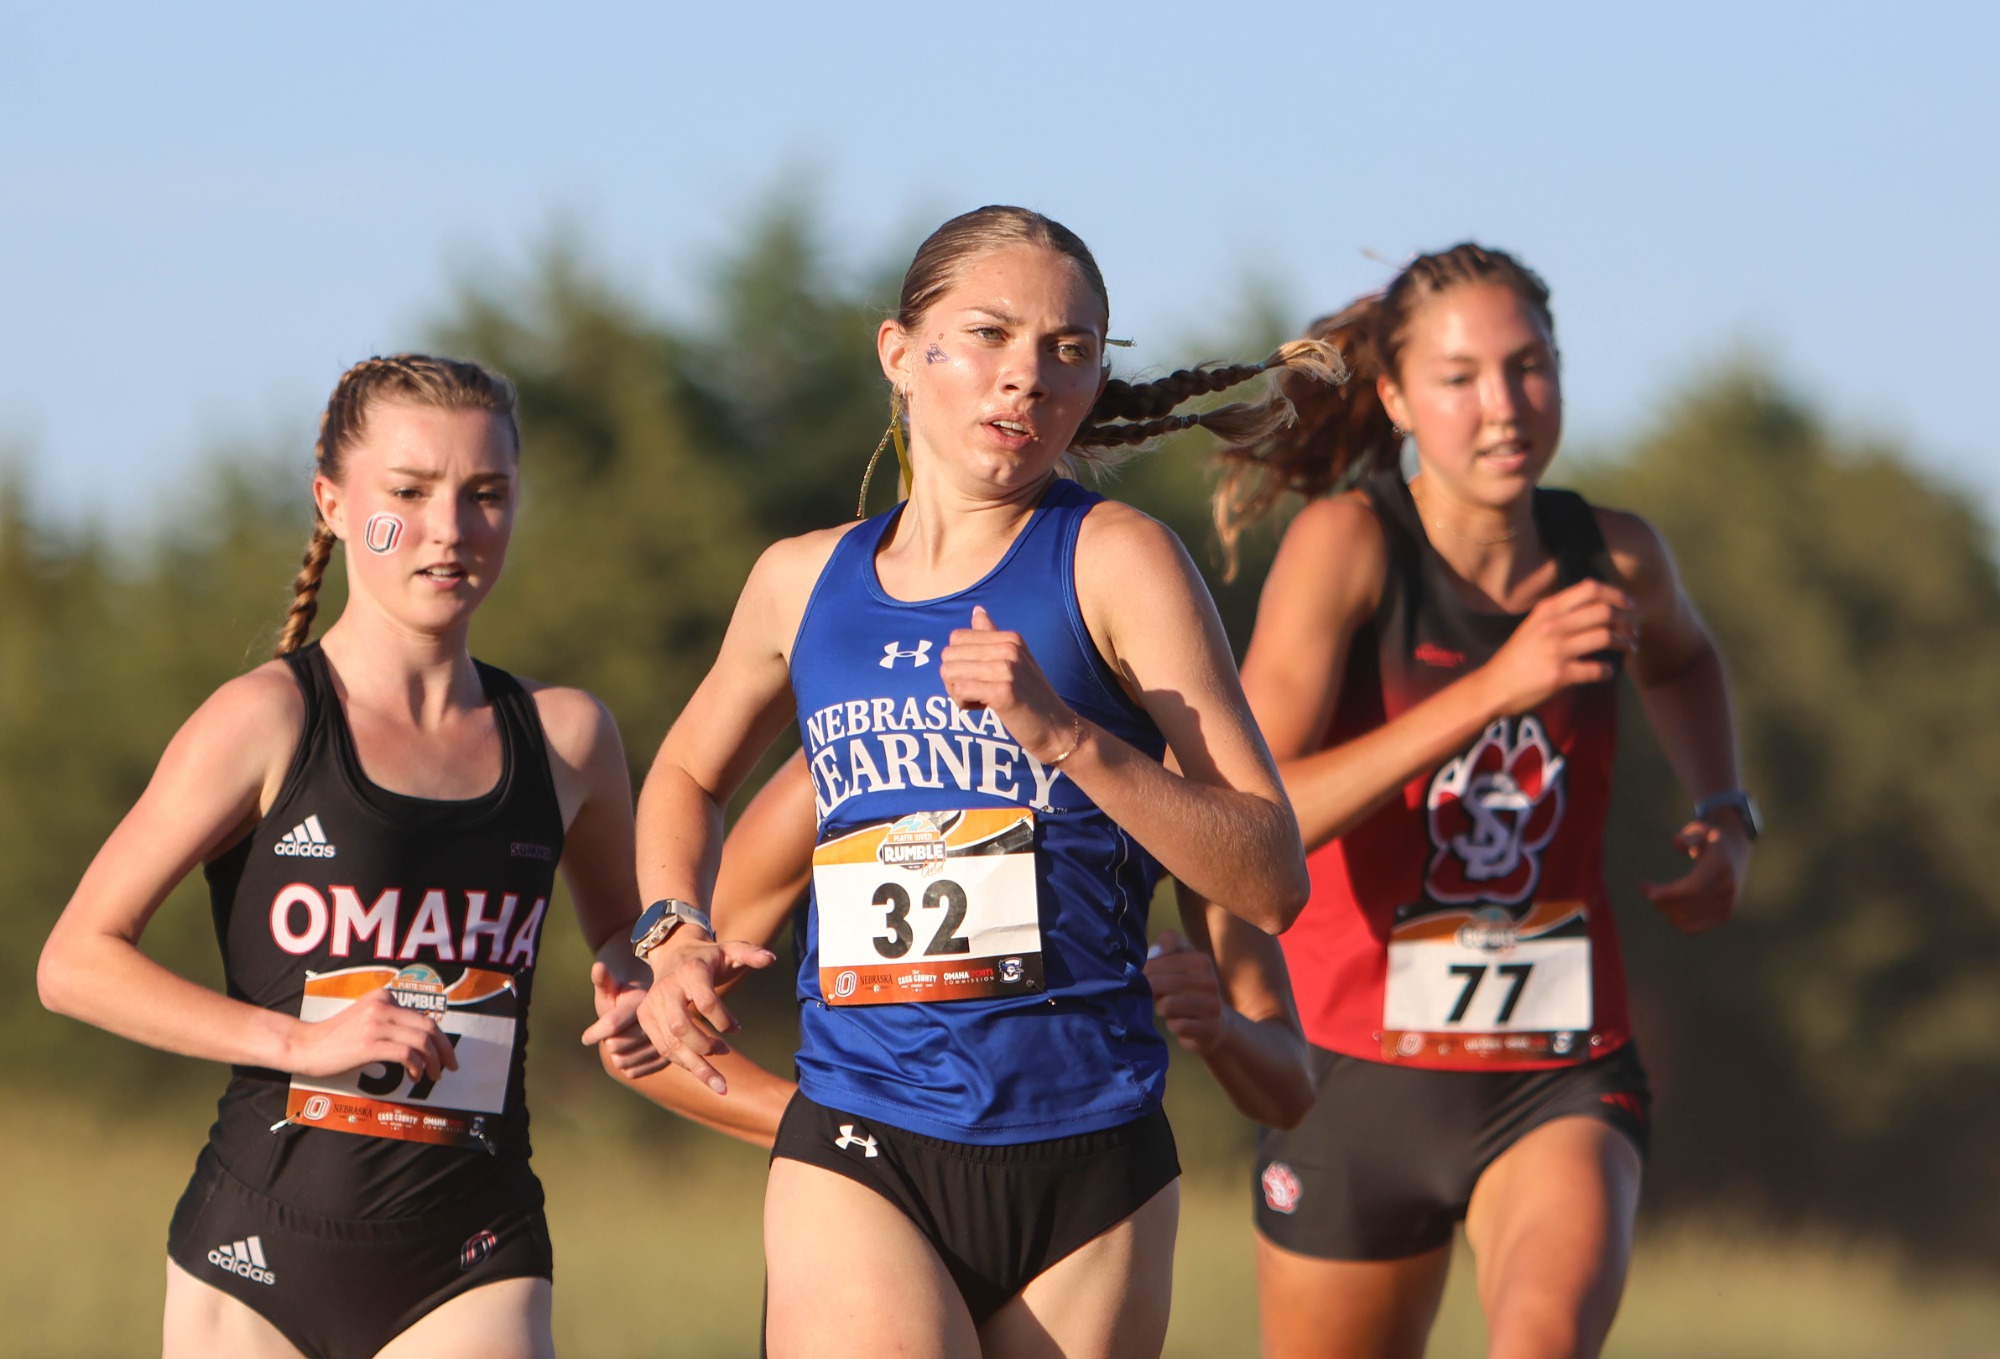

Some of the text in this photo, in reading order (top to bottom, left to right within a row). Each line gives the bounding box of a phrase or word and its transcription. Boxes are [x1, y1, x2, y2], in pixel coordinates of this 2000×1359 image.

[806, 696, 1010, 754] NEBRASKA
[811, 732, 1062, 830] KEARNEY
[274, 841, 337, 859] adidas
[884, 843, 945, 863] RUMBLE
[269, 882, 549, 968] OMAHA
[872, 880, 970, 959] 32
[859, 973, 894, 986] NEBRASKA
[897, 973, 938, 985] CASS COUNTY
[943, 971, 970, 981] OMAHA
[944, 975, 995, 986] COMMISSION
[1447, 963, 1535, 1025] 77
[333, 1103, 373, 1117] NEBRASKA
[423, 1115, 448, 1127] OMAHA
[207, 1249, 277, 1286] adidas
